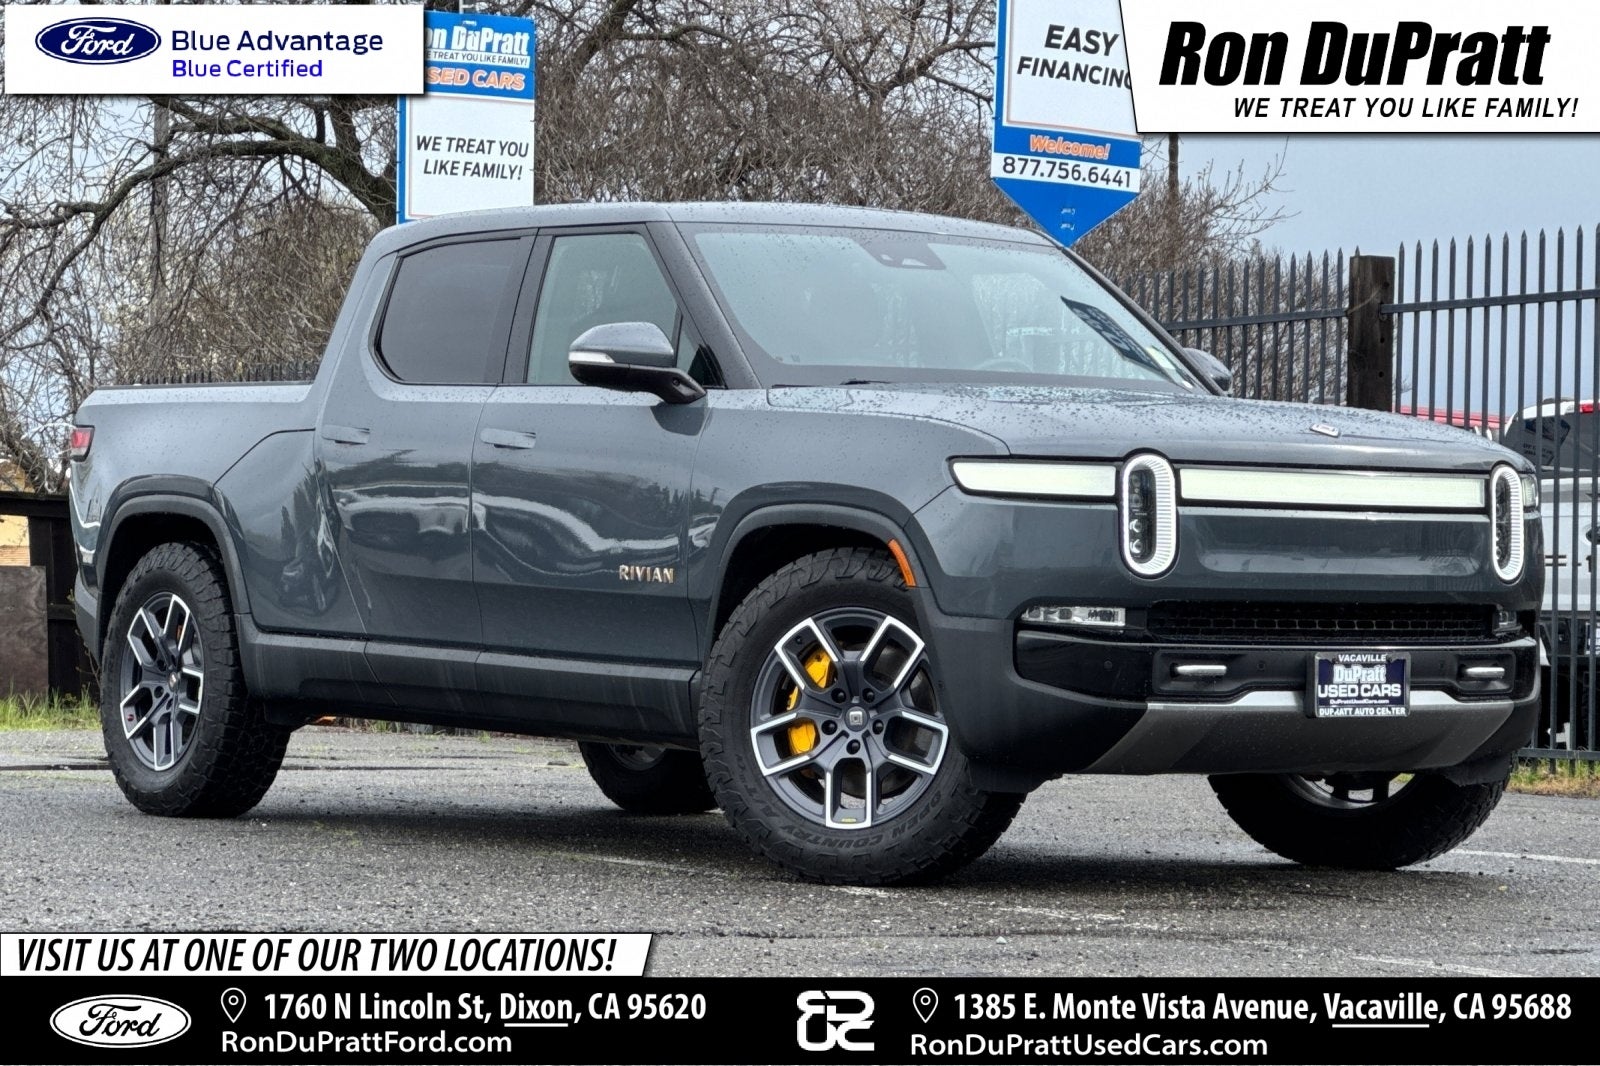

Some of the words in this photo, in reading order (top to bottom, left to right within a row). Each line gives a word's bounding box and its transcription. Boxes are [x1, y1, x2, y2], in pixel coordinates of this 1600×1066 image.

[424, 27, 447, 49] on
[451, 25, 530, 55] DuPratt
[1044, 24, 1120, 57] EASY
[433, 51, 459, 60] TREAT
[462, 52, 478, 61] YOU
[480, 54, 497, 63] LIKE
[498, 55, 528, 66] FAMILY!
[424, 66, 470, 86] SED
[472, 69, 526, 91] CARS
[417, 135, 442, 152] WE
[446, 137, 496, 155] TREAT
[499, 140, 529, 158] YOU
[1030, 134, 1111, 160] Welcome!
[424, 158, 460, 176] LIKE
[462, 161, 523, 180] FAMILY!
[1002, 156, 1131, 188] 877.756.6441
[619, 564, 674, 584] RIVIAN
[1338, 654, 1387, 662] VACAVILLE
[1333, 664, 1387, 684] DuPratt
[1318, 684, 1359, 697] USED
[1360, 684, 1402, 697] CARS
[1354, 707, 1374, 715] AUTO
